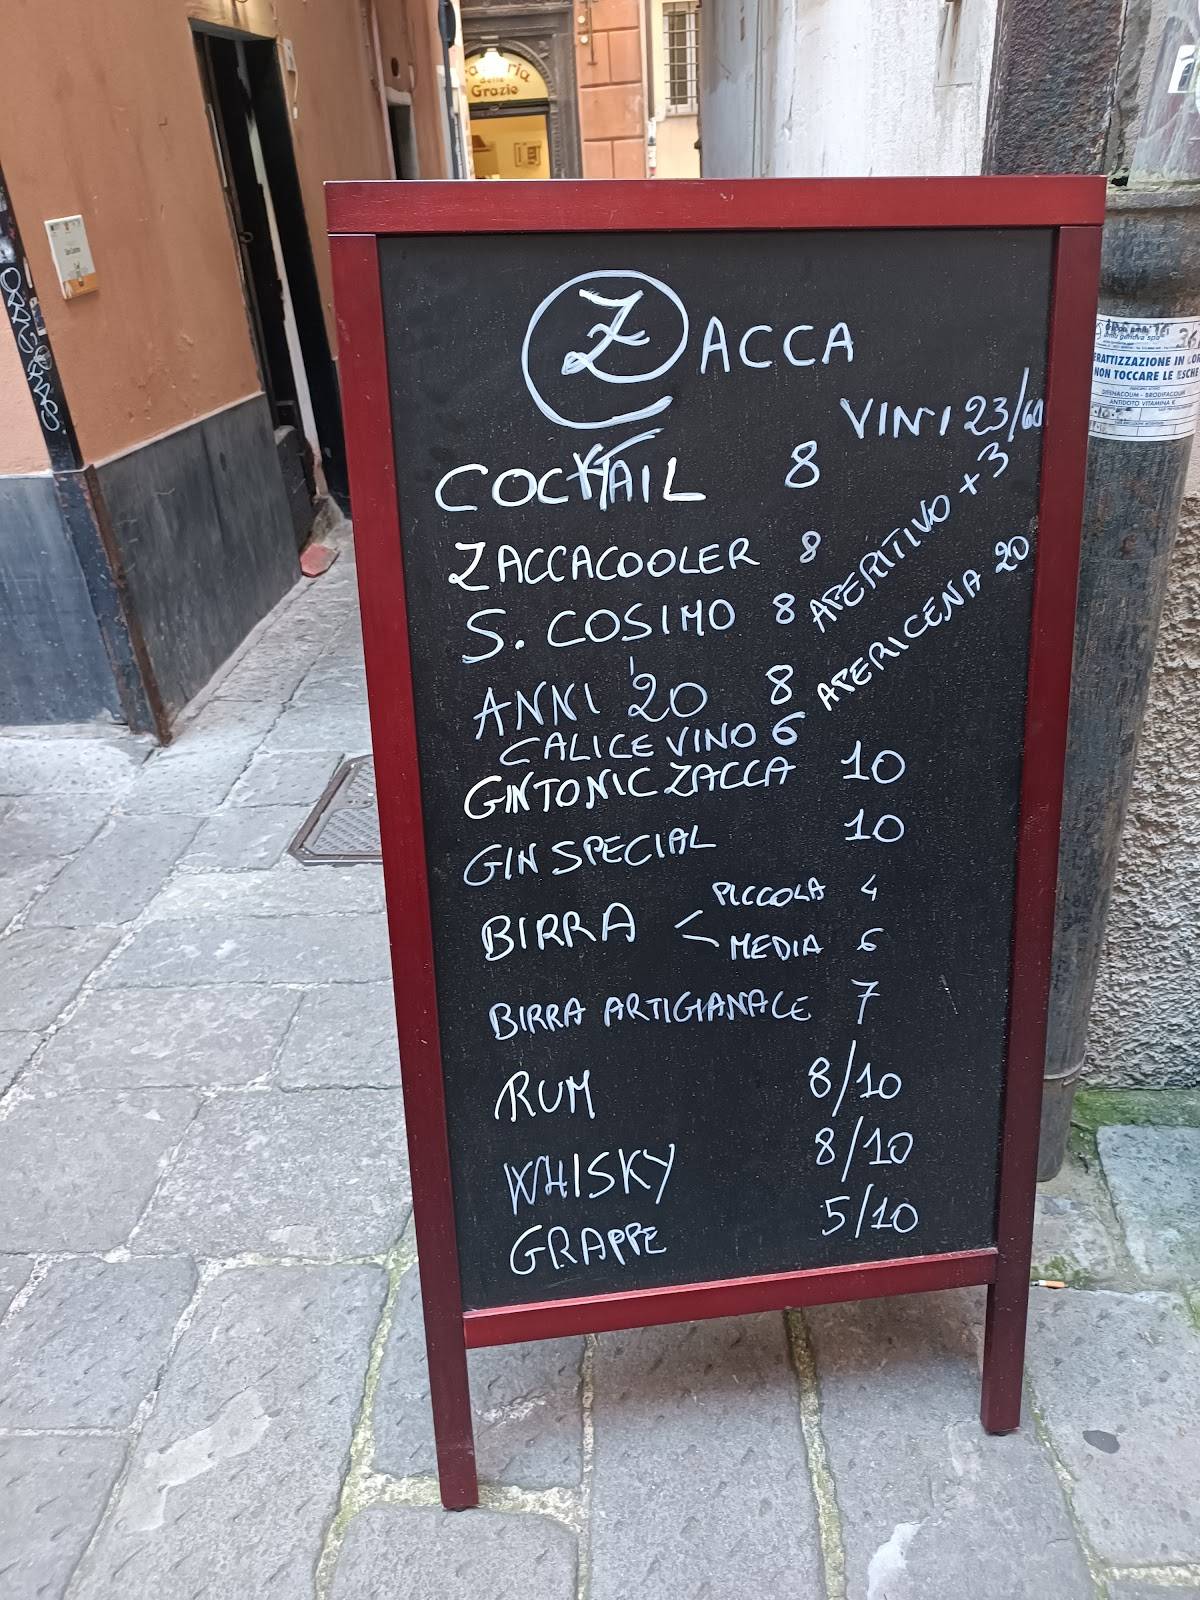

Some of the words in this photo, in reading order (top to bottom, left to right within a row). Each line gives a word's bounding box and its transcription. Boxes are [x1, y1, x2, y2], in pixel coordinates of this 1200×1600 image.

[471, 84, 518, 97] Grazie
[1092, 352, 1171, 367] ERATTIZZAZIONE
[1174, 356, 1185, 366] IN
[1094, 367, 1111, 379] NON
[1114, 369, 1159, 381] TOCCARE
[1163, 370, 1174, 381] LE
[1177, 367, 1199, 380] ESCHE
[840, 398, 951, 439] VINI
[435, 428, 706, 511] COCKTAIL
[785, 441, 819, 488] 8
[448, 538, 760, 591] ZACCACOOLER
[800, 531, 821, 563] 8
[809, 495, 950, 633] APERITIVO
[462, 609, 524, 663] S.
[547, 599, 735, 647] COSIMO
[773, 593, 795, 624] 8
[817, 569, 981, 711] APERICENA
[995, 536, 1029, 573] 20
[473, 681, 600, 740] ANNI
[766, 665, 793, 705] 8
[499, 728, 654, 765] CALICE
[666, 723, 756, 756] VINO
[772, 712, 805, 745] 6
[664, 757, 796, 797] ZACCA
[841, 741, 905, 783] 10
[464, 843, 538, 886] GIN
[552, 825, 716, 875] SPECIAL
[844, 809, 904, 842] 10
[712, 877, 825, 906] PICCOLA
[861, 874, 877, 901] 4
[482, 903, 635, 961] BIRRA
[731, 933, 823, 960] MEDIA
[857, 928, 883, 951] 6
[489, 998, 586, 1040] BIRRA
[604, 989, 811, 1026] ARTIGIANALE
[852, 979, 880, 1024] 7
[495, 1070, 595, 1122] RUM
[808, 1040, 901, 1117] 8/10
[504, 1144, 675, 1215] WHISKY
[815, 1116, 913, 1182] 8/10
[510, 1223, 666, 1274] GRAPPE
[822, 1184, 918, 1238] 5/10
